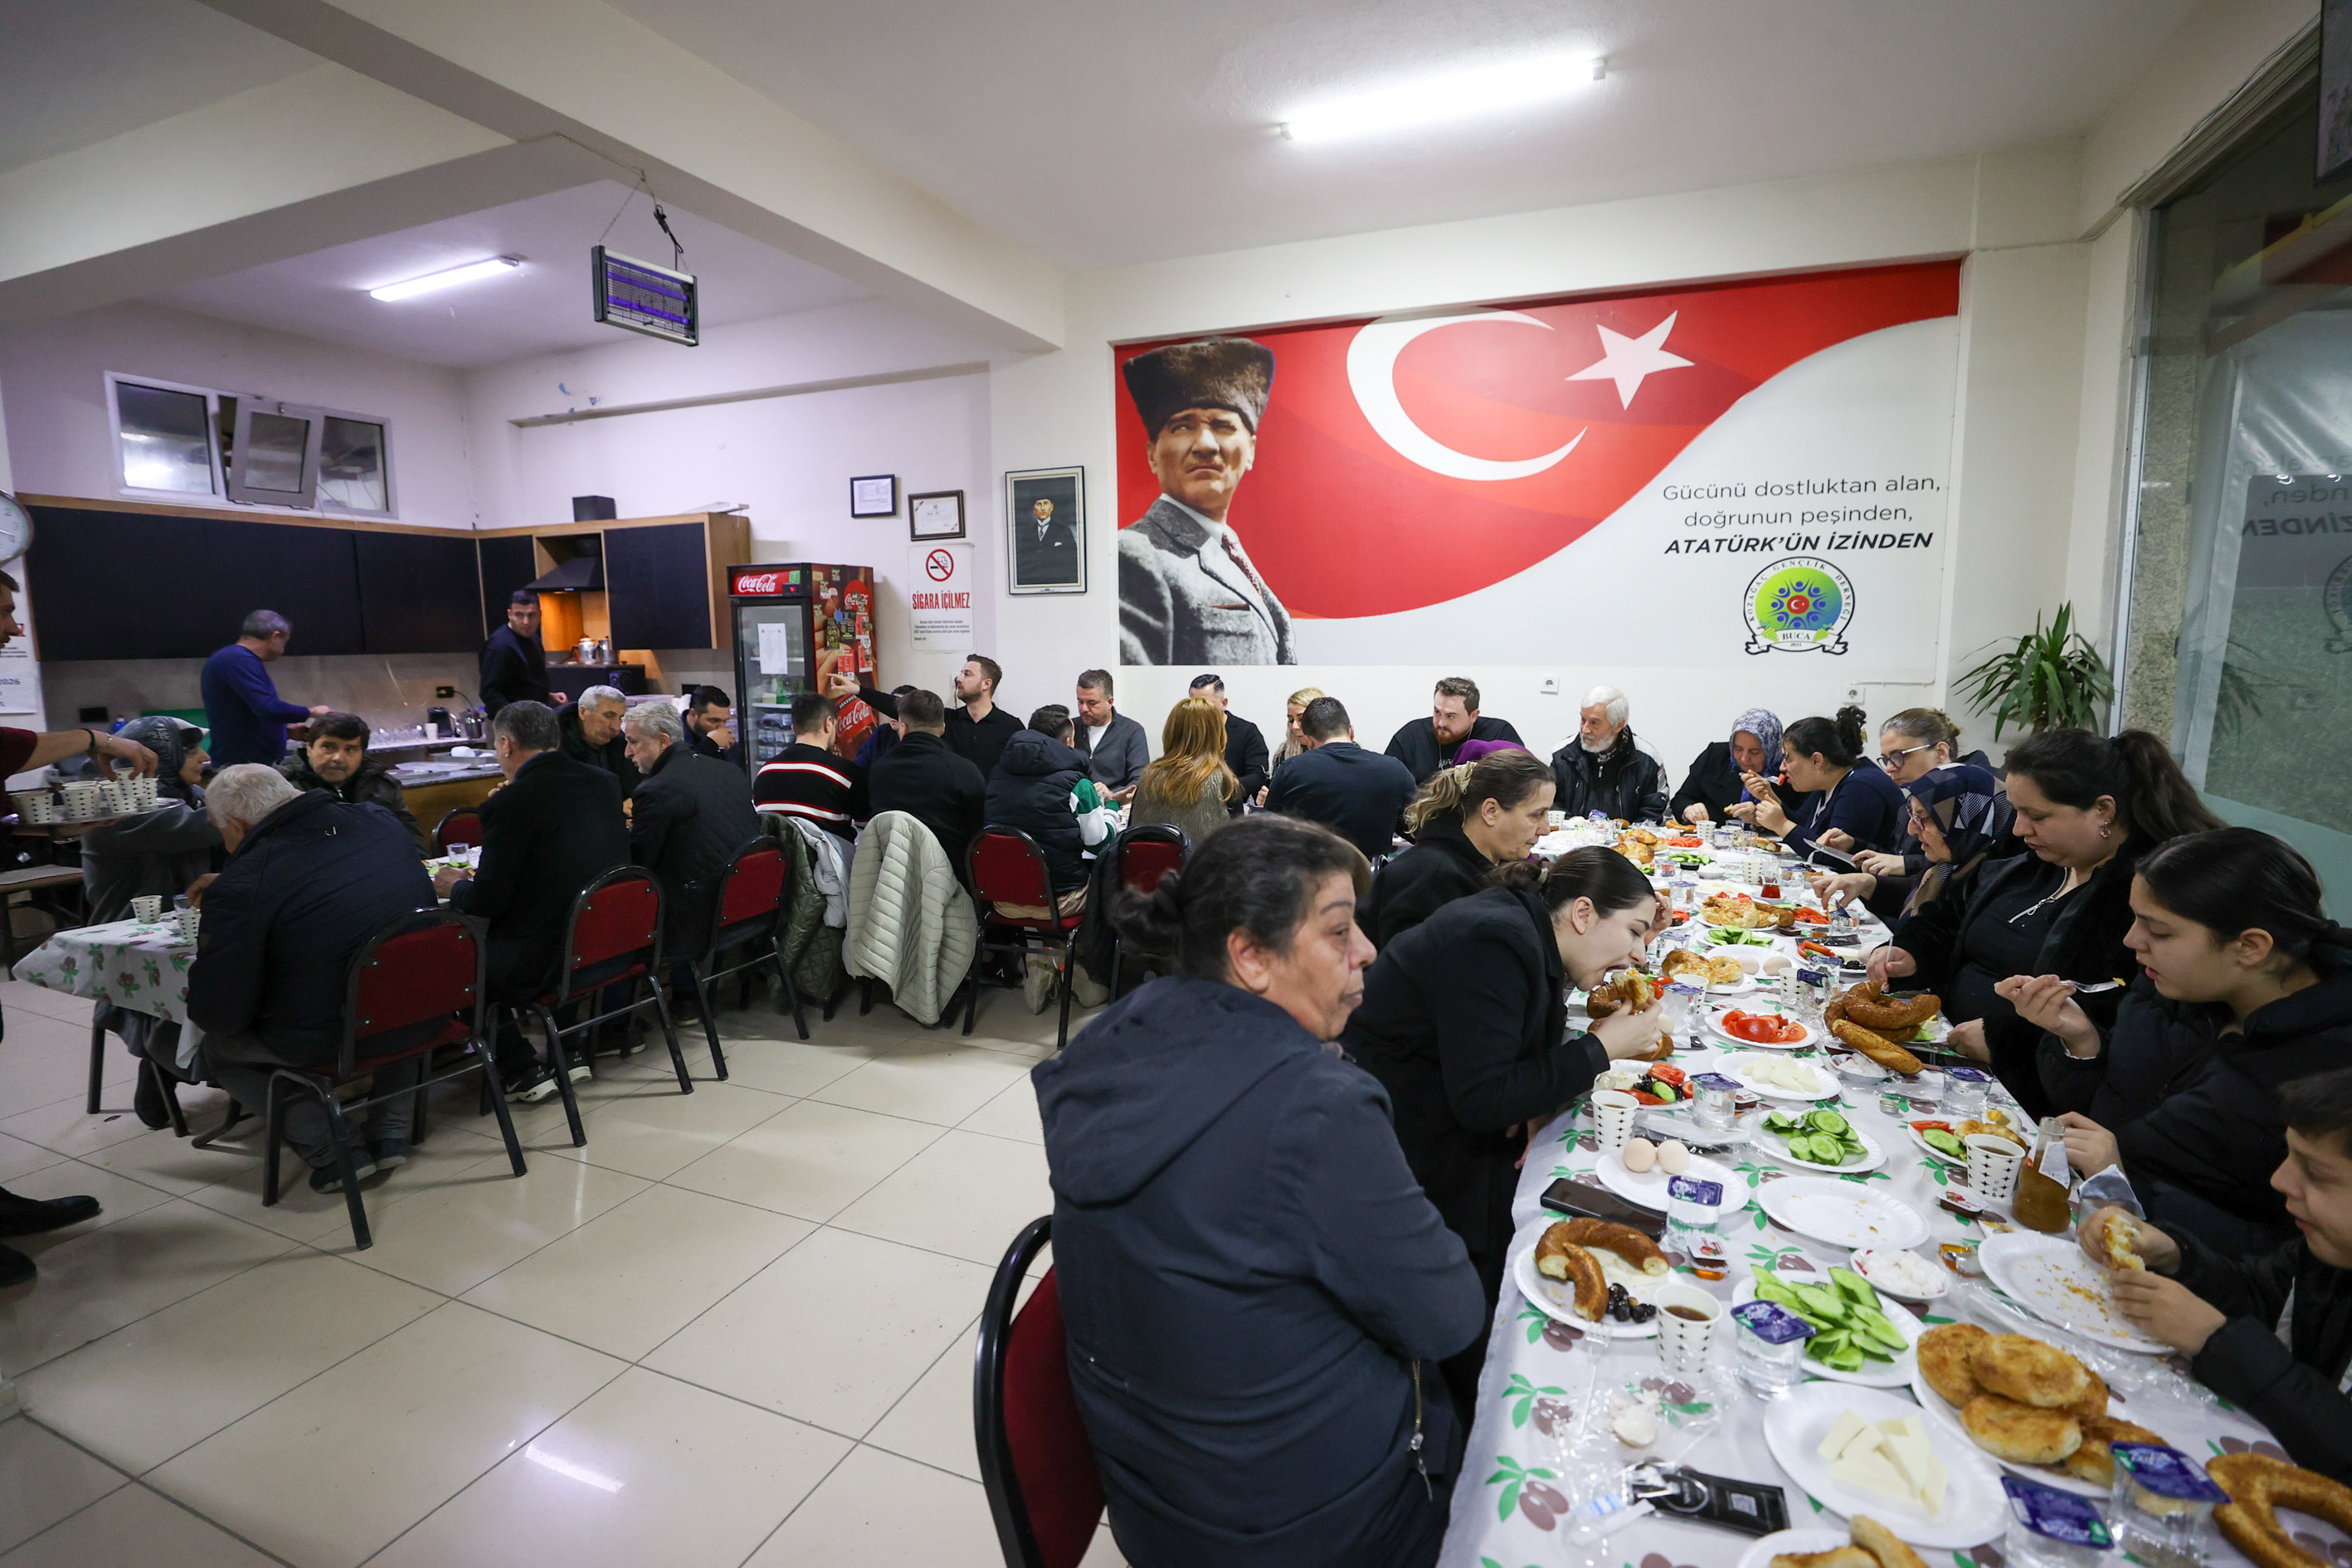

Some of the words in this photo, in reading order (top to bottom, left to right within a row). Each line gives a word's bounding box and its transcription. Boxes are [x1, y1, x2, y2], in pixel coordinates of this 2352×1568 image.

[1663, 483, 1746, 500] Gücünü
[1755, 478, 1877, 497] dostluktan
[1886, 475, 1941, 492] alan,
[1684, 511, 1792, 528] doğrunun
[1801, 505, 1913, 526] peşinden,
[1664, 533, 1821, 554] ATATÜRK’ÜN
[1827, 531, 1934, 550] İZİNDEN
[1773, 559, 1827, 571] GENÇLİK
[912, 591, 940, 610] SİGARA
[941, 590, 970, 611] İÇİLMEZ
